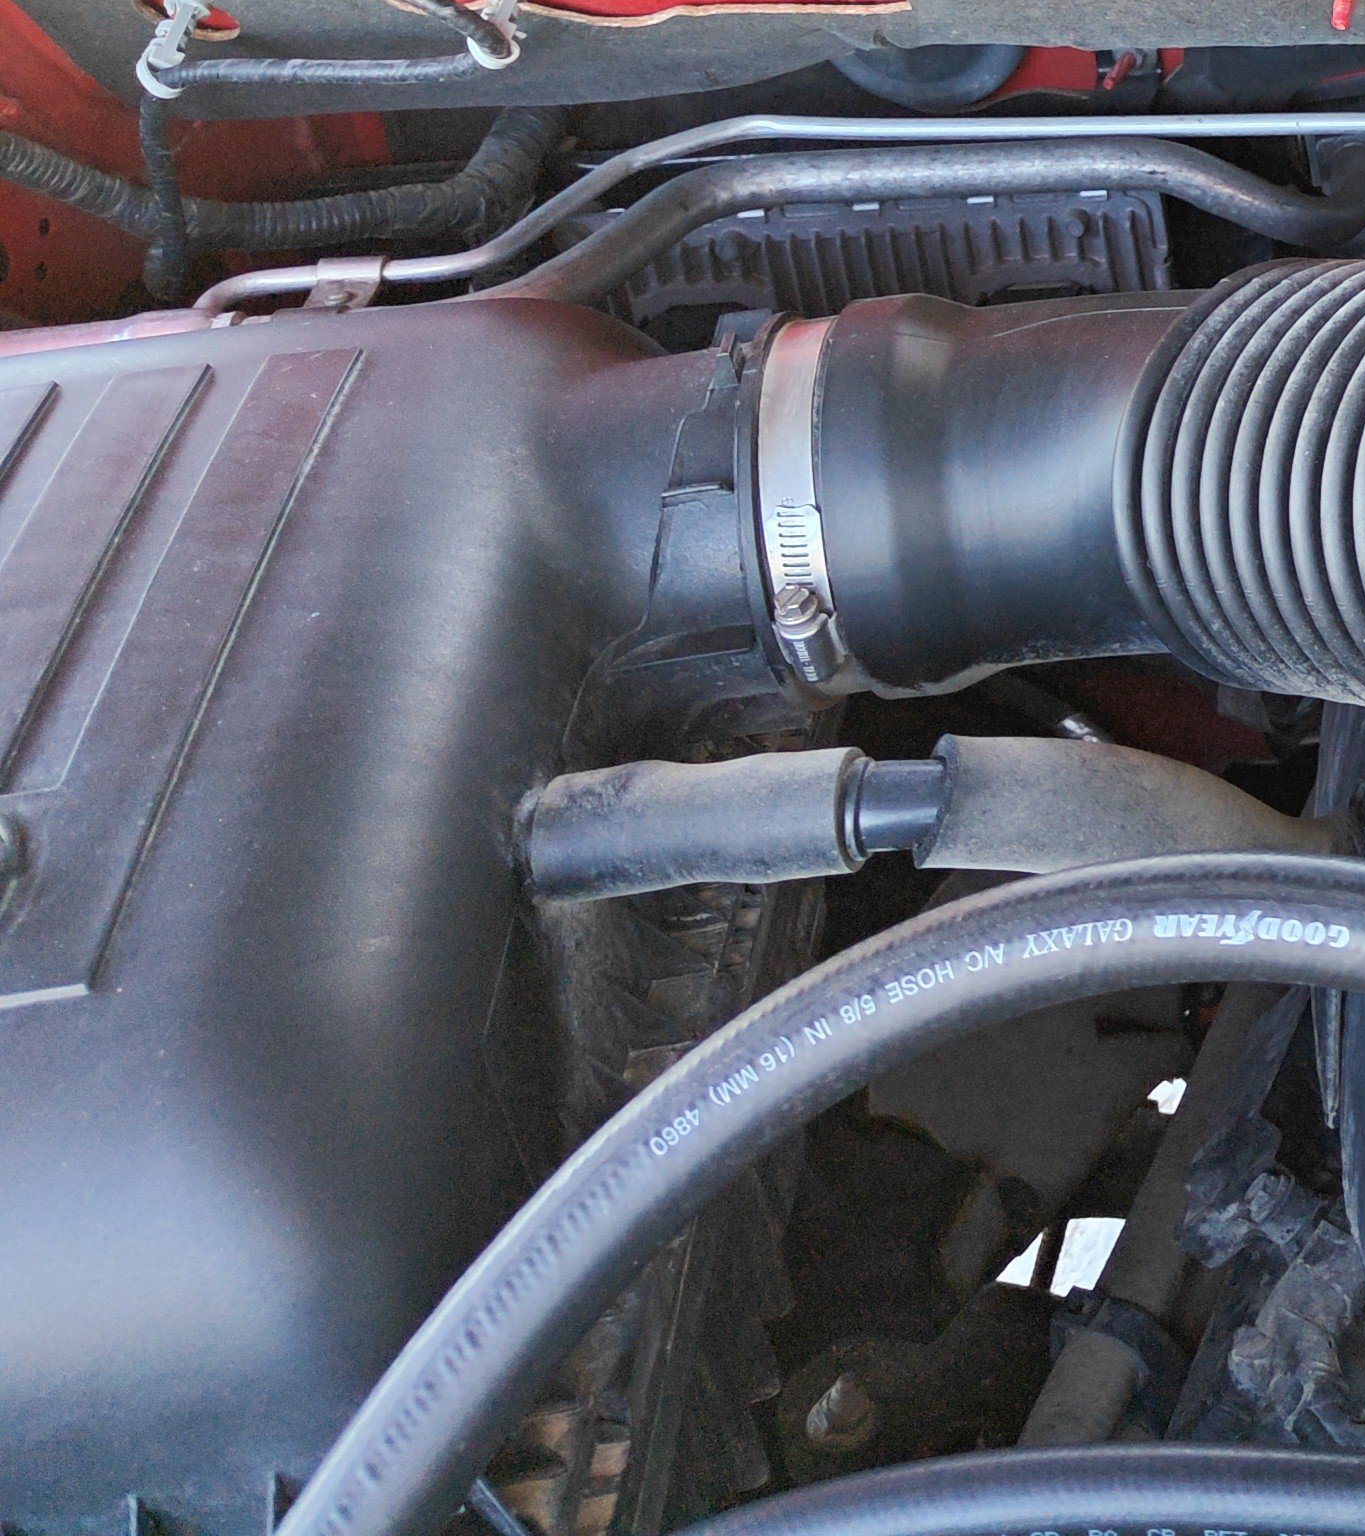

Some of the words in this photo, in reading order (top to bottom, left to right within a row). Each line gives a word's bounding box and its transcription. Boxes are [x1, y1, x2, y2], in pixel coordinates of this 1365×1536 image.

[1020, 917, 1134, 960] GALAXY
[1152, 910, 1351, 948] GOODYEAR
[967, 942, 1006, 973] A/C
[884, 959, 956, 1004] HOSE
[840, 992, 877, 1026] 5/8
[760, 1034, 797, 1072] (16
[804, 1023, 834, 1049] IN
[708, 1066, 761, 1109] MM)
[649, 1106, 702, 1157] 4860
